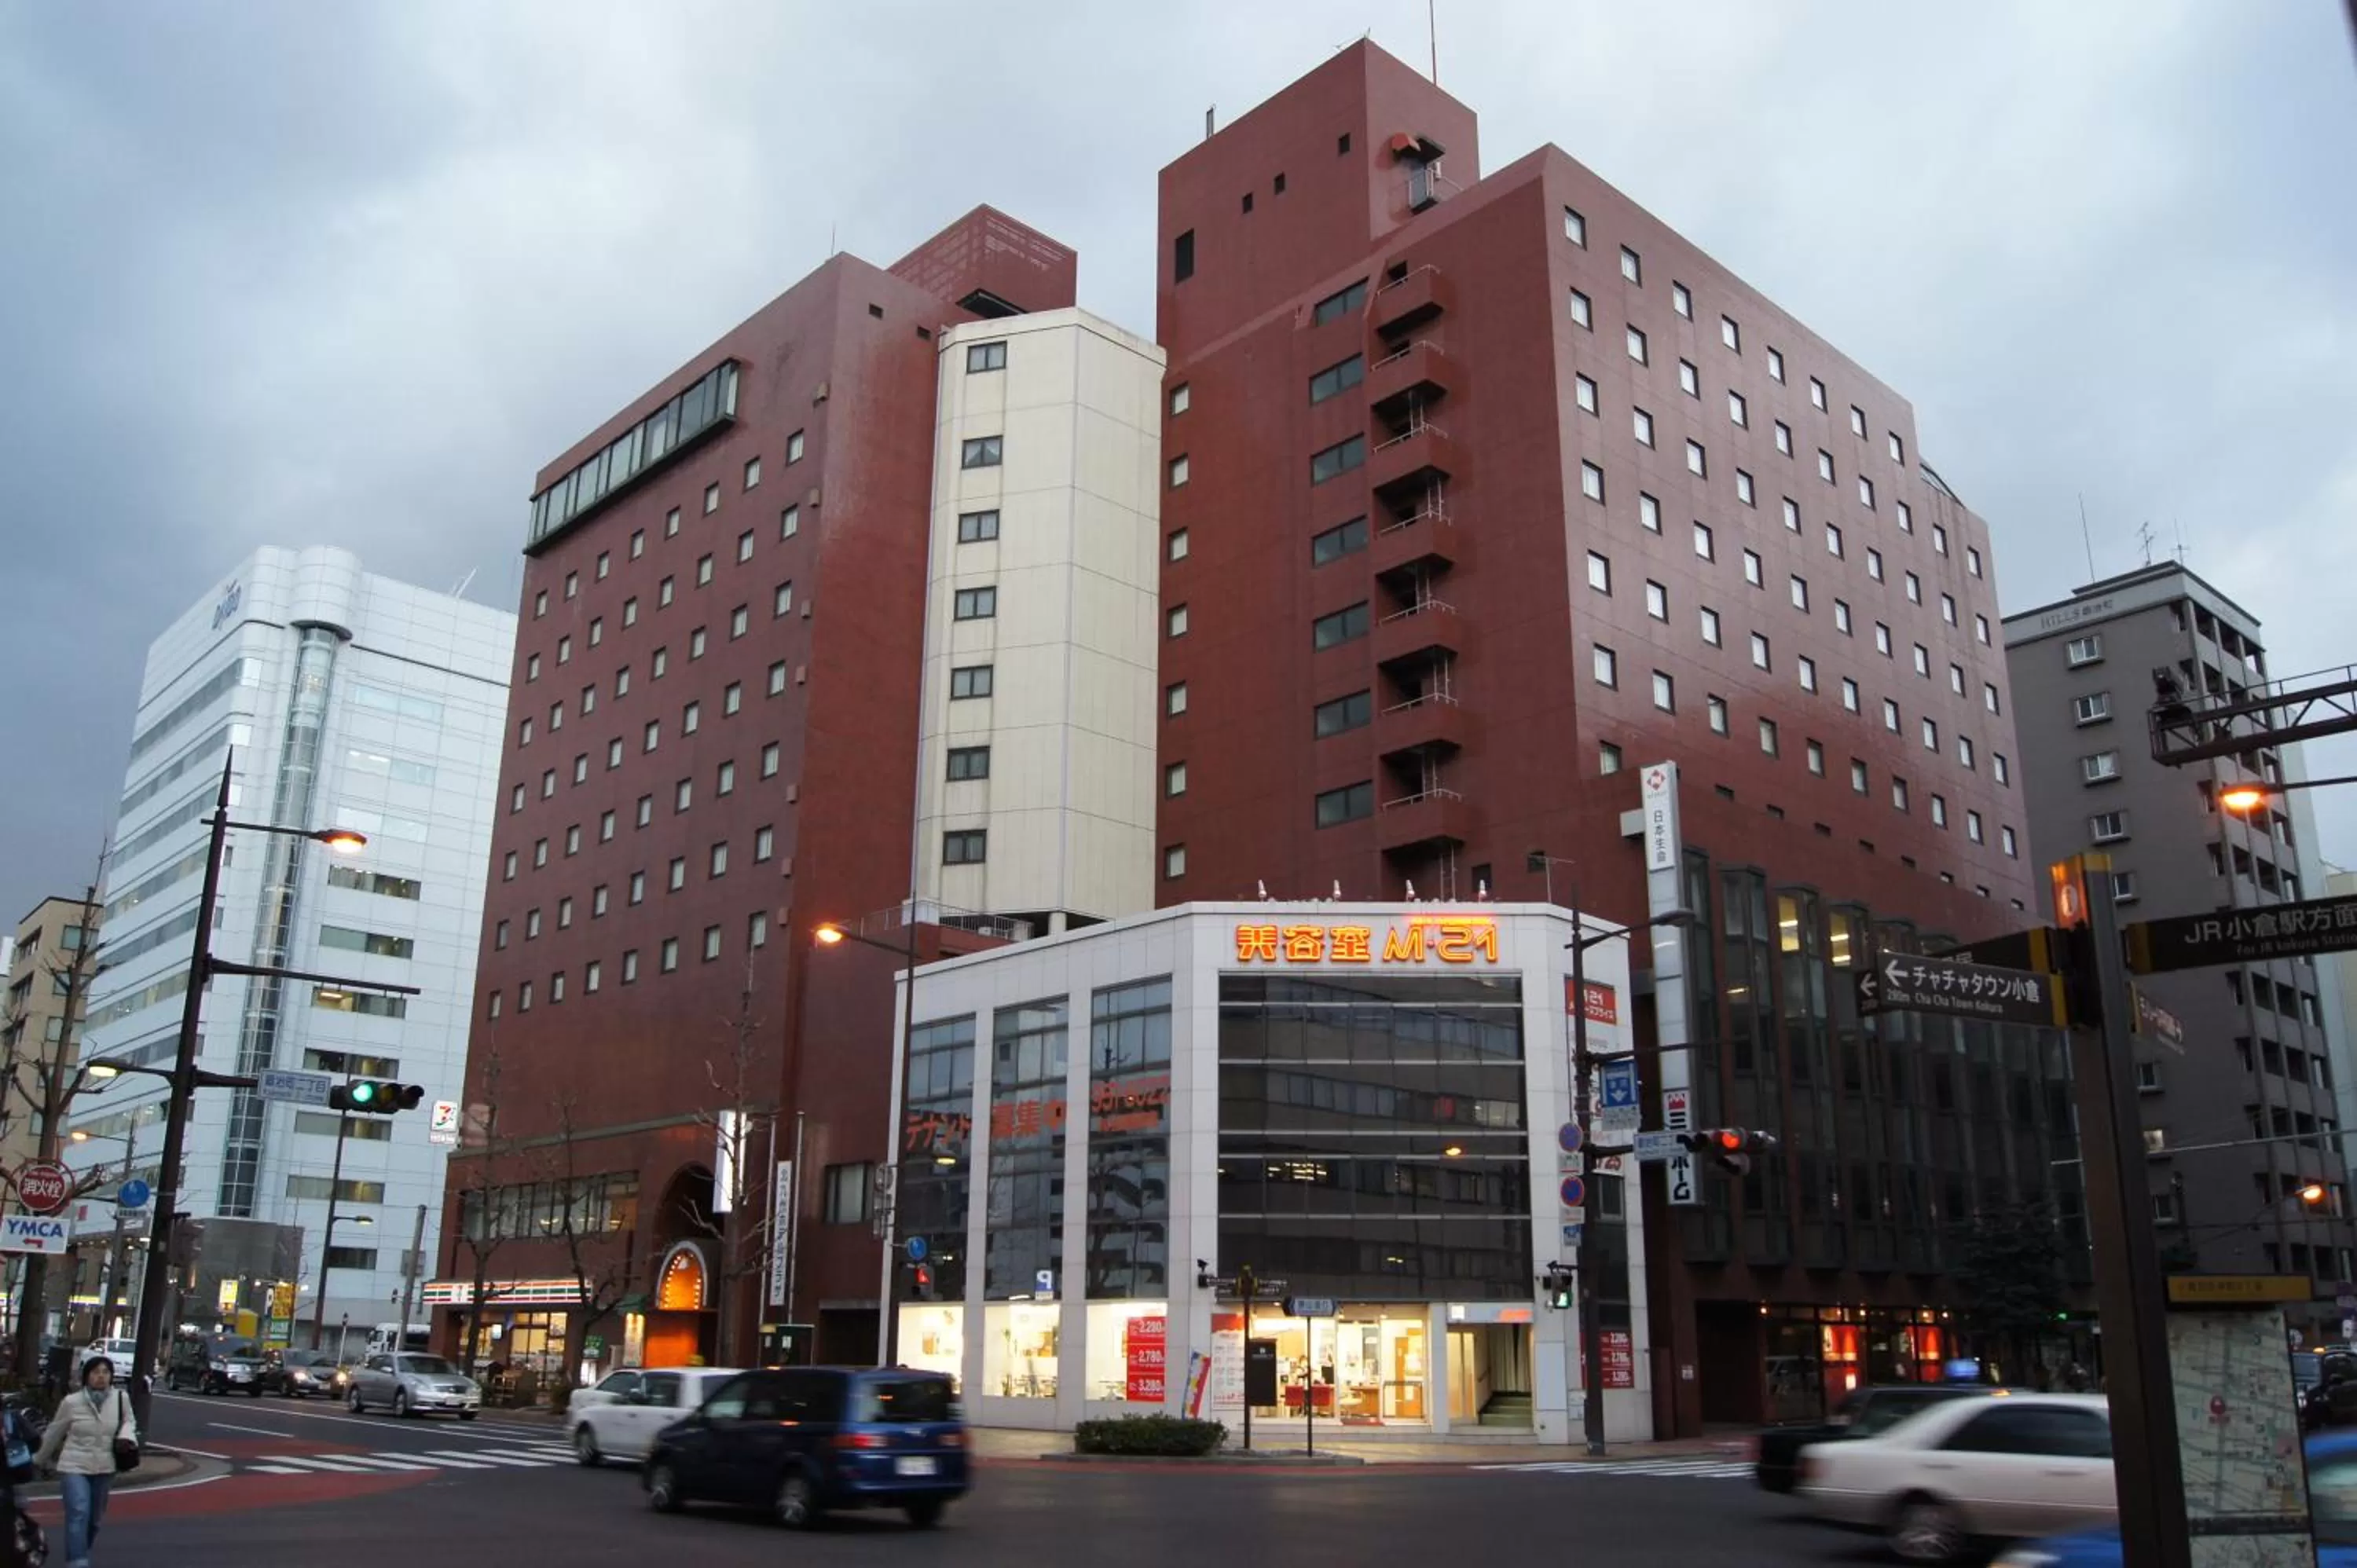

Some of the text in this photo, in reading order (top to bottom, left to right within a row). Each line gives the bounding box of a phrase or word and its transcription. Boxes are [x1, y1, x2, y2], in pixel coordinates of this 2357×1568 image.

[2184, 904, 2357, 943] JR小倉駅方面
[1236, 925, 1372, 962] 美容室
[1912, 966, 2040, 1003] チャチャタウン小倉
[906, 1111, 972, 1150] テナント
[992, 1097, 1066, 1138] 募集中
[1669, 1112, 1691, 1200] 三ホーム
[22, 1178, 62, 1199] 消火栓
[7, 1218, 64, 1238] YMCA
